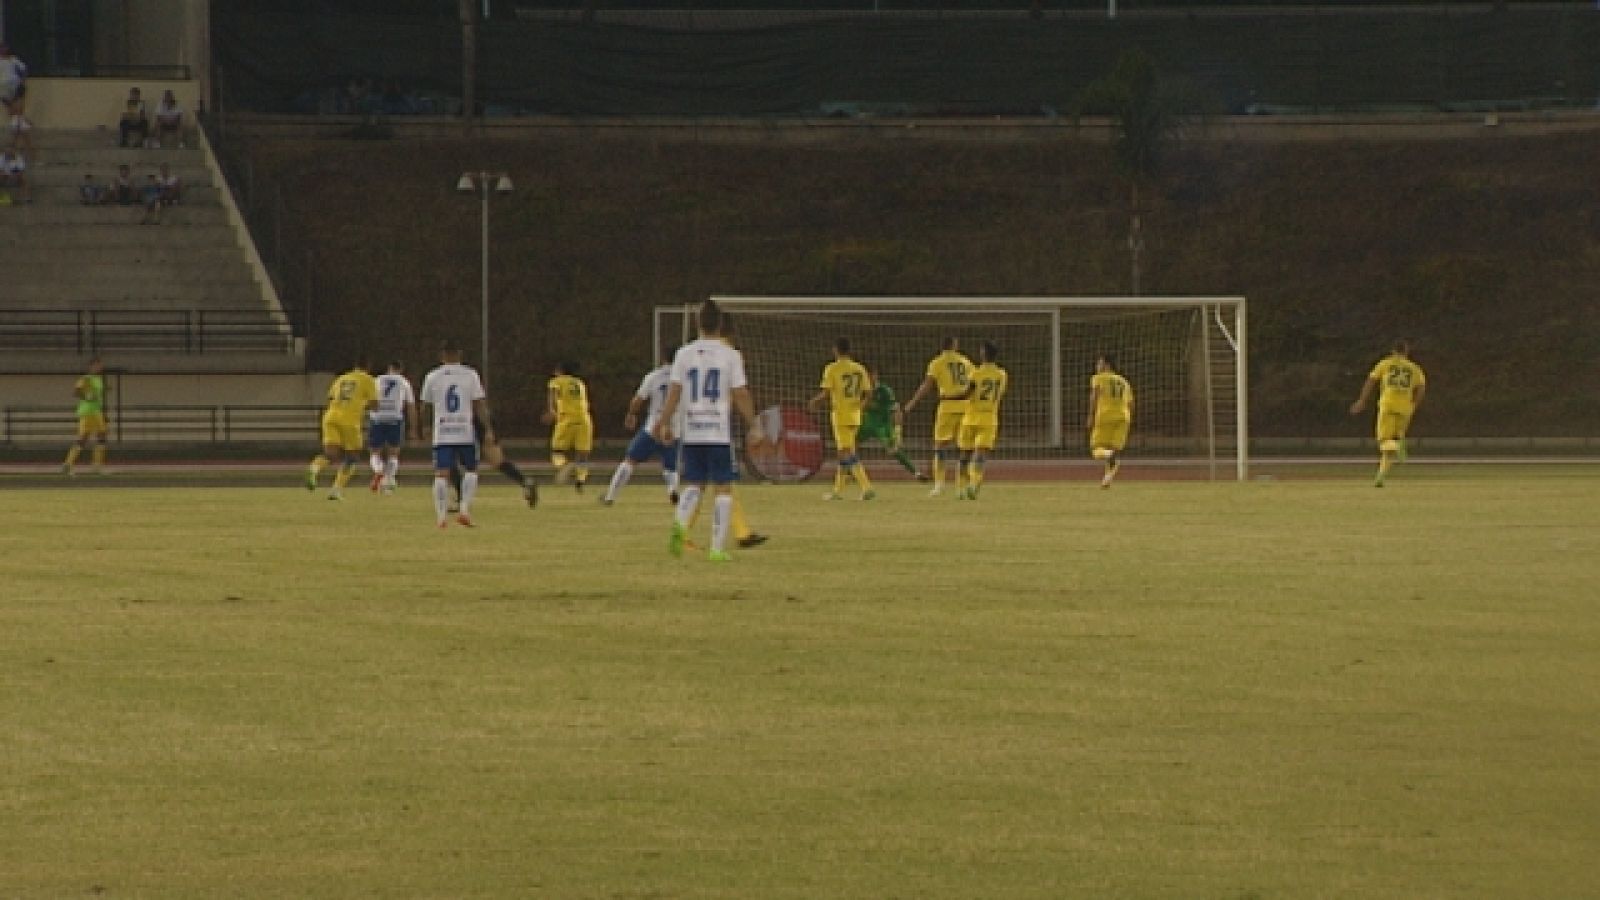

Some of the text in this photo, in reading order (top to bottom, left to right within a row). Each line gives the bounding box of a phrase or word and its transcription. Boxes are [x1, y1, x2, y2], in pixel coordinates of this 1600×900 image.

[384, 379, 396, 397] 7
[687, 367, 721, 403] 14
[1388, 365, 1412, 388] 23
[447, 384, 459, 413] 6
